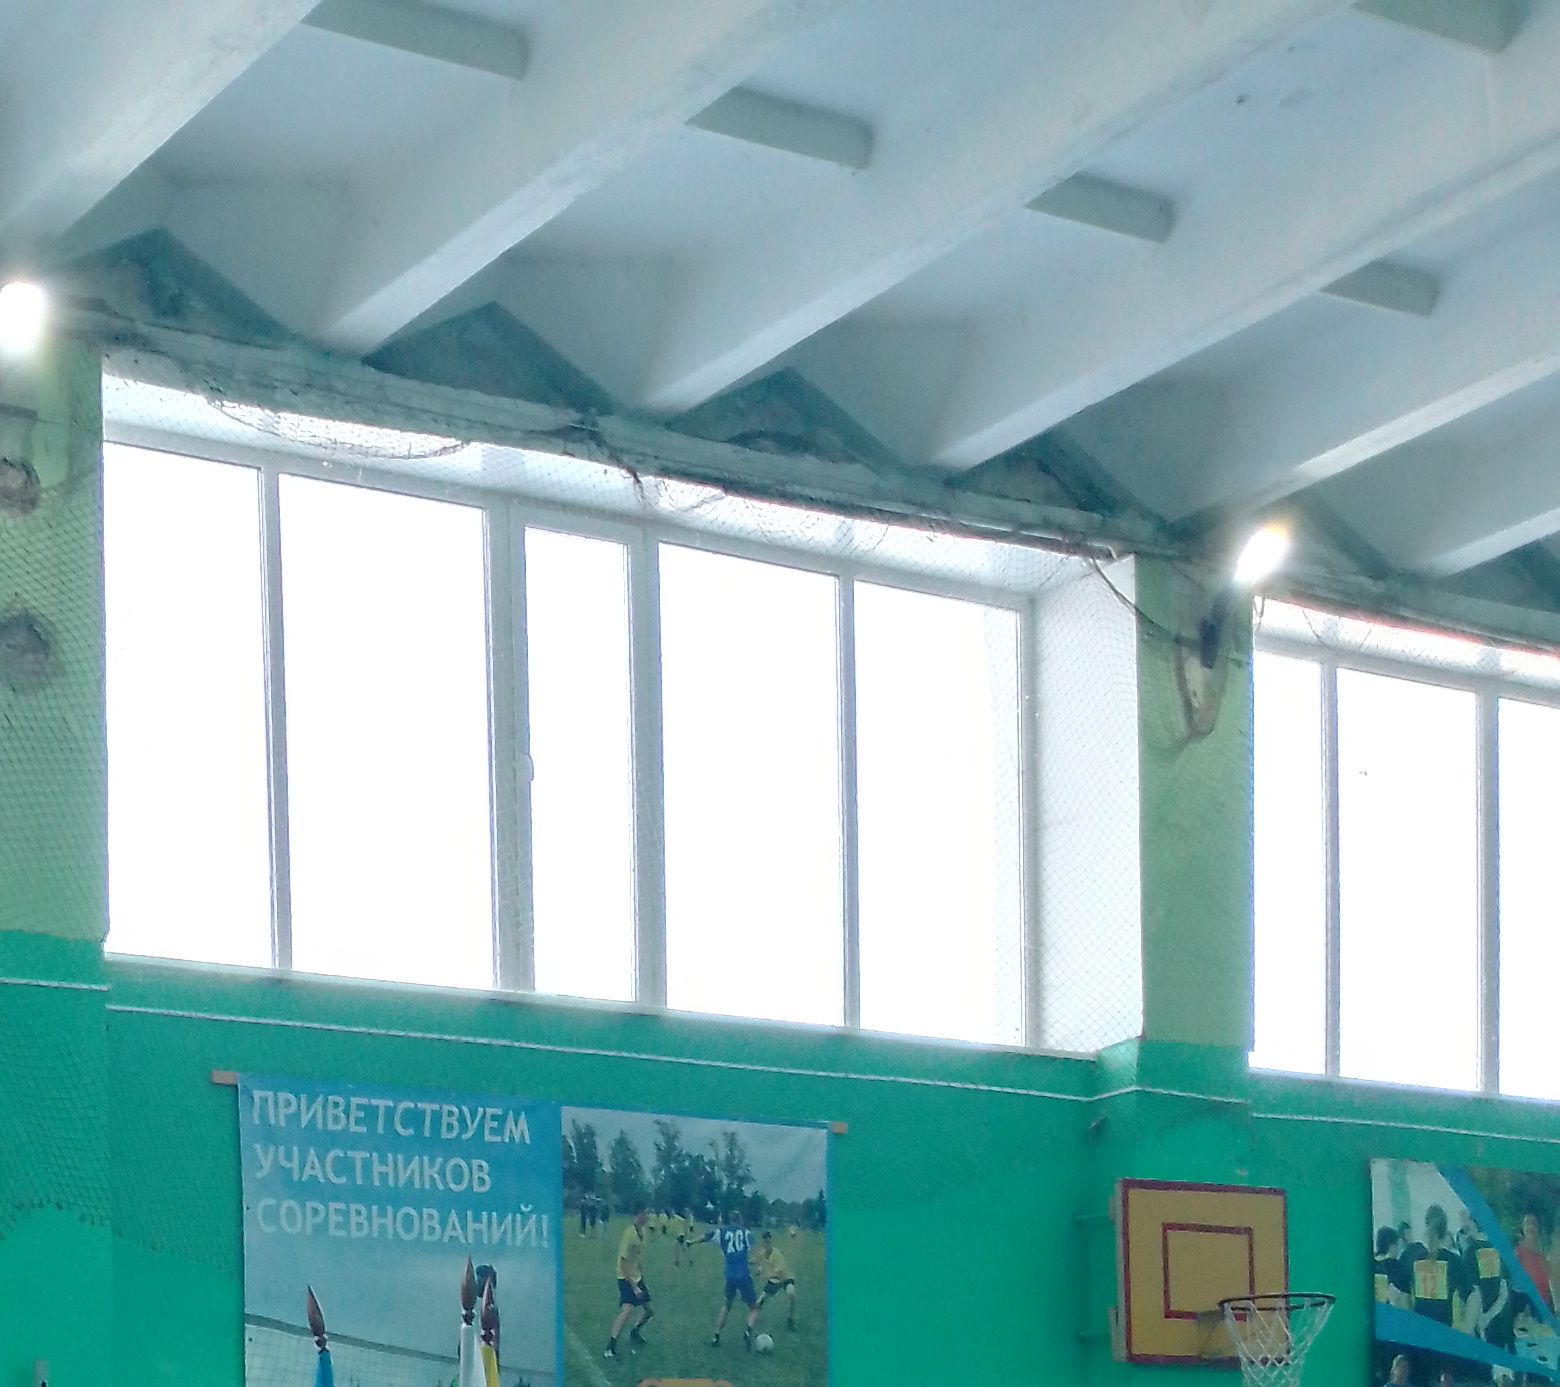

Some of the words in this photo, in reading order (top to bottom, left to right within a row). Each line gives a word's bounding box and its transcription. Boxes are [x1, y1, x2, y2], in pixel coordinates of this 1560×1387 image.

[251, 1090, 531, 1144] ПРИВЕТСТВУЕМ
[253, 1143, 491, 1193] УЧАСТНИКОВ
[256, 1198, 550, 1248] СОРЕВНОВАНИЙ!
